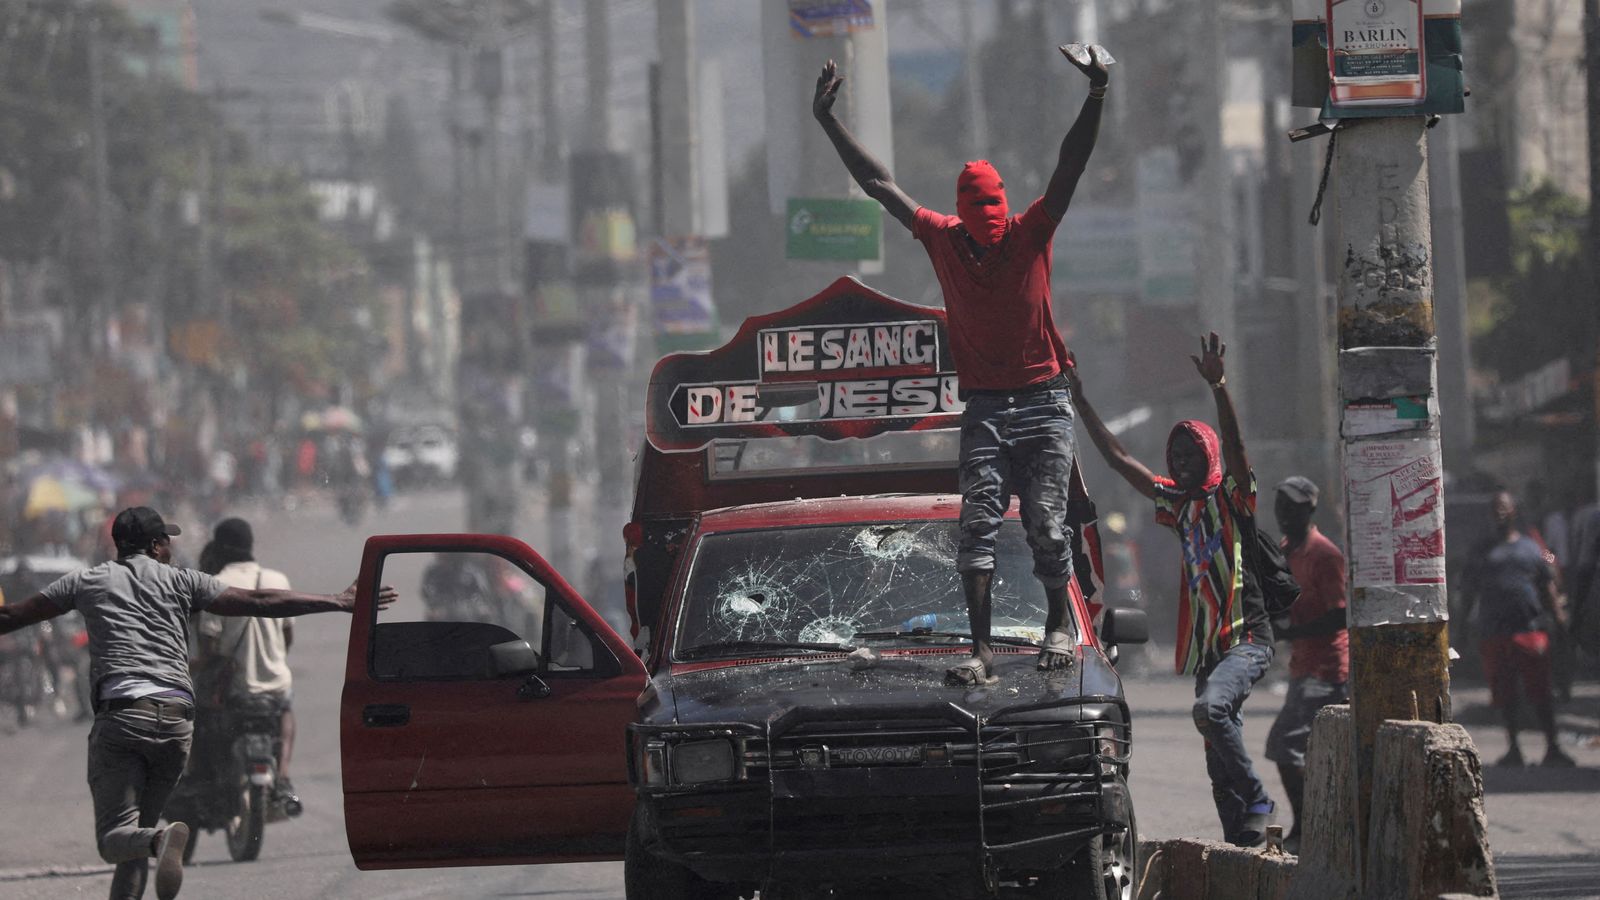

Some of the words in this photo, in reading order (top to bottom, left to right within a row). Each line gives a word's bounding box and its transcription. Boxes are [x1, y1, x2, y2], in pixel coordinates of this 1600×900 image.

[1344, 29, 1407, 43] BARLIN
[764, 331, 815, 371] LE
[821, 325, 936, 370] SANG
[687, 385, 756, 424] DE
[841, 748, 921, 763] TOYOTA
